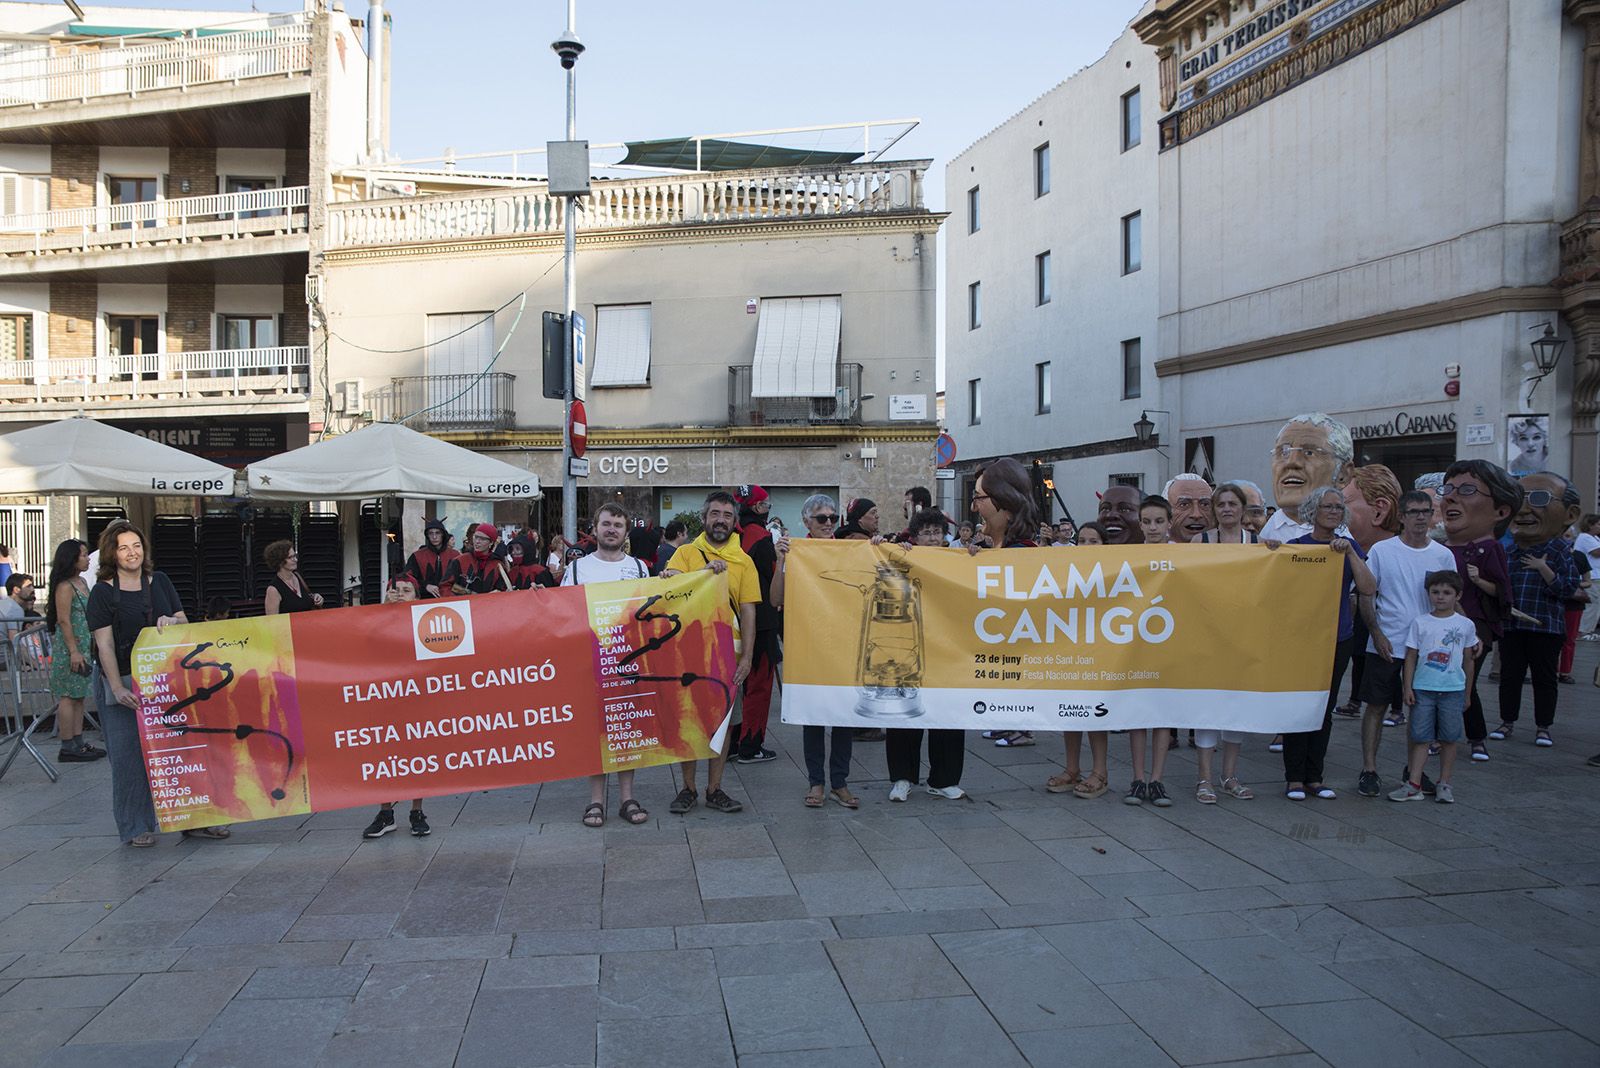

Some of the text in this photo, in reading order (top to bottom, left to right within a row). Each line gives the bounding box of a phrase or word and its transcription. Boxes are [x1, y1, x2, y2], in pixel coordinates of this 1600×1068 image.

[1181, 44, 1219, 81] GRAN
[1351, 421, 1394, 438] FUNDACIÓ
[599, 456, 669, 479] crepe
[152, 477, 224, 493] la crepe
[469, 483, 530, 496] la crepe
[1291, 554, 1327, 563] flama.cat
[976, 560, 1175, 600] FLAMA DEL
[595, 605, 621, 615] FOCS
[596, 617, 610, 625] DE
[974, 594, 1175, 644] CANIGÓ
[598, 625, 623, 636] SANT
[216, 637, 249, 650] Canigó
[424, 634, 460, 644] ÒMNIUM
[599, 635, 625, 646] JOAN
[600, 644, 633, 656] FLAMA
[137, 652, 167, 663] FOCS
[600, 656, 620, 666] DEL
[975, 654, 1095, 665] 23 de juny Focs de Sant Joan
[138, 664, 153, 674] DE
[601, 661, 639, 676] CANIGÓ
[140, 673, 168, 684] SANT
[342, 659, 556, 703] FLAMA DEL CANIGÓ
[975, 670, 986, 679] 24
[988, 670, 1000, 679] de
[1002, 670, 1022, 681] juny
[1023, 670, 1044, 680] Festa
[1045, 670, 1080, 680] Nacional
[1081, 670, 1098, 681] dels
[1127, 669, 1160, 680] Catalans
[140, 684, 170, 695] JOAN
[142, 694, 179, 705] FLAMA
[143, 706, 165, 715] DEL
[604, 702, 635, 713] FESTA
[989, 703, 1035, 712] ÒMNIUM
[144, 712, 187, 726] CANIGÓ
[605, 709, 655, 723] NACIONAL
[334, 704, 574, 749] FESTA NACIONAL DELS
[606, 721, 632, 732] DELS
[607, 730, 643, 742] PAÏSOS
[608, 737, 659, 751] CATALANS
[148, 755, 183, 767] FESTA
[361, 740, 556, 781] PAÏSOS CATALANS
[150, 763, 207, 777] NACIONAL
[151, 777, 179, 788] DELS
[153, 786, 192, 799] PAÏSOS
[154, 794, 210, 810] CATALANS
